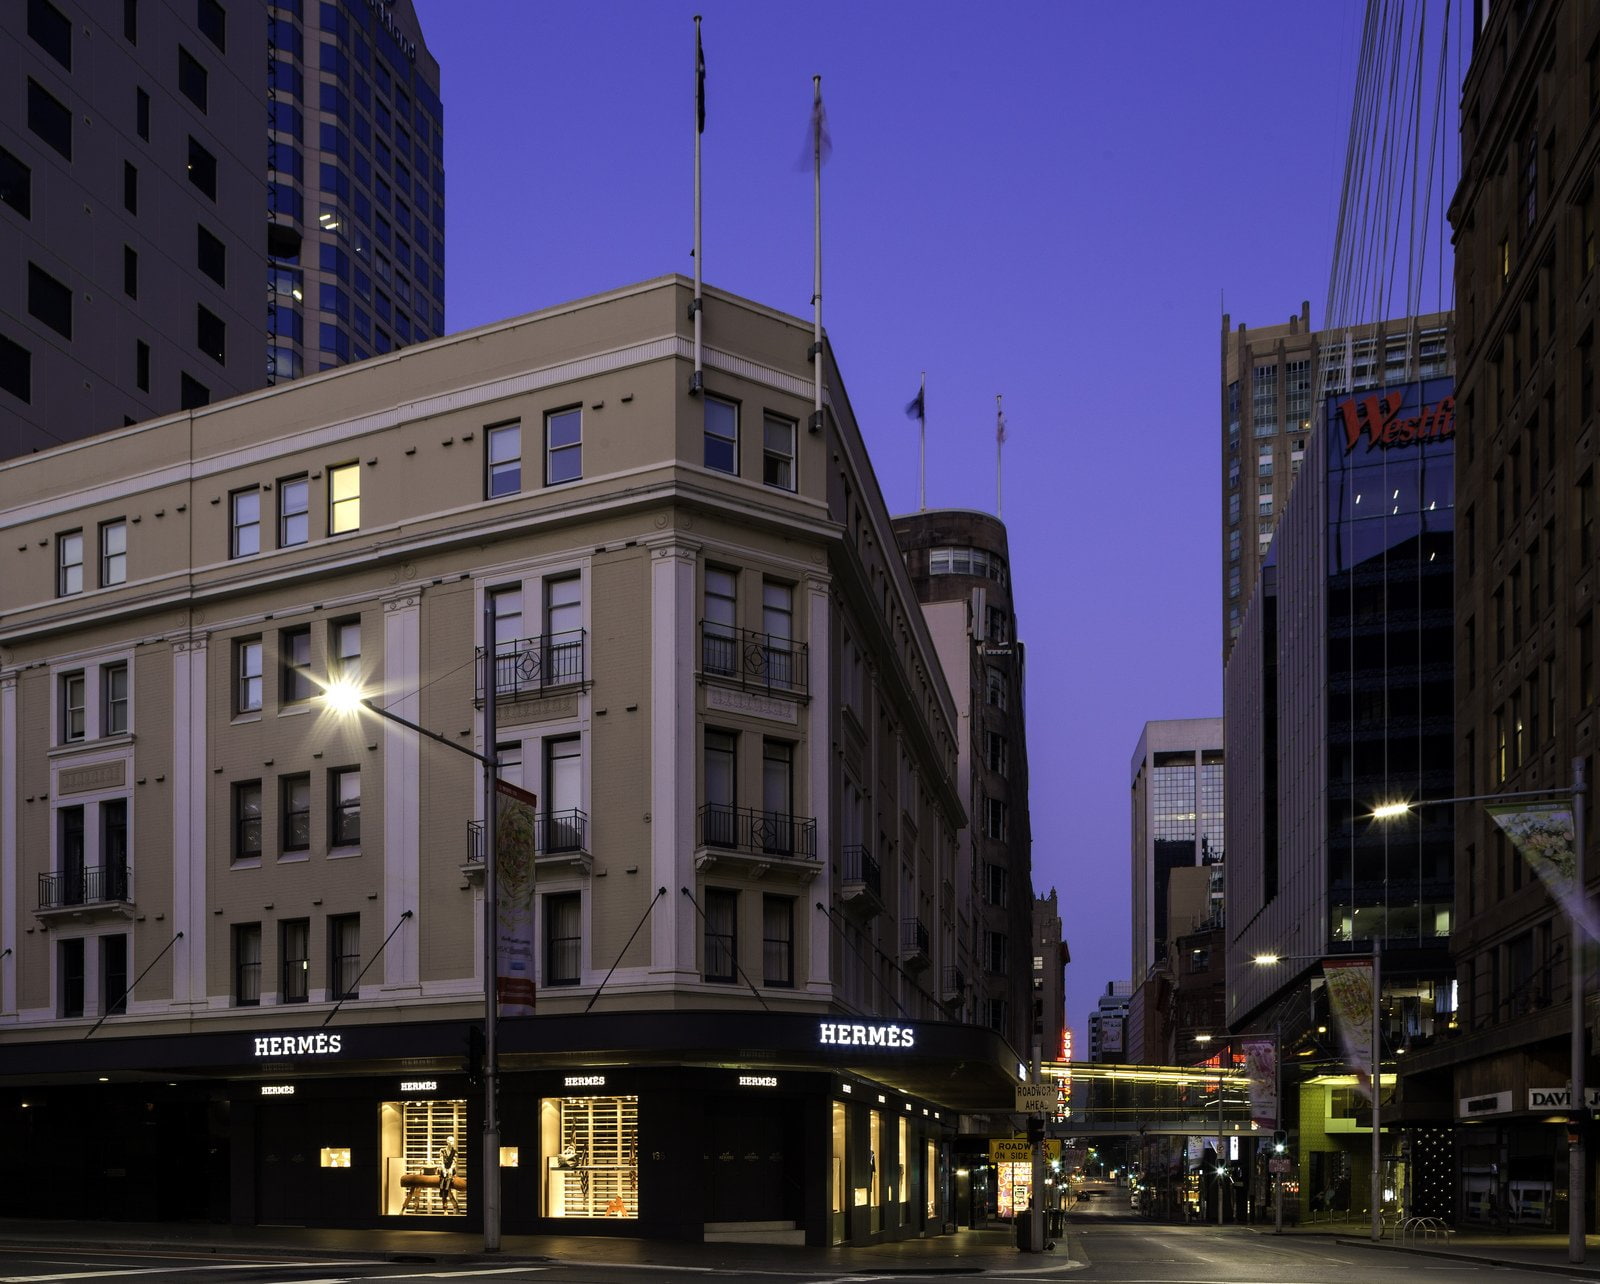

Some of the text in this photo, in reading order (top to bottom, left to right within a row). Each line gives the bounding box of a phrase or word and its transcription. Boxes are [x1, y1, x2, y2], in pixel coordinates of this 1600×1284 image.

[1335, 391, 1456, 450] Westfi
[1064, 1031, 1072, 1095] GOWIGS
[1532, 1092, 1571, 1106] DAVI
[998, 1142, 1051, 1151] ROADWK
[994, 1152, 1005, 1160] ON
[1010, 1152, 1028, 1160] SIDE
